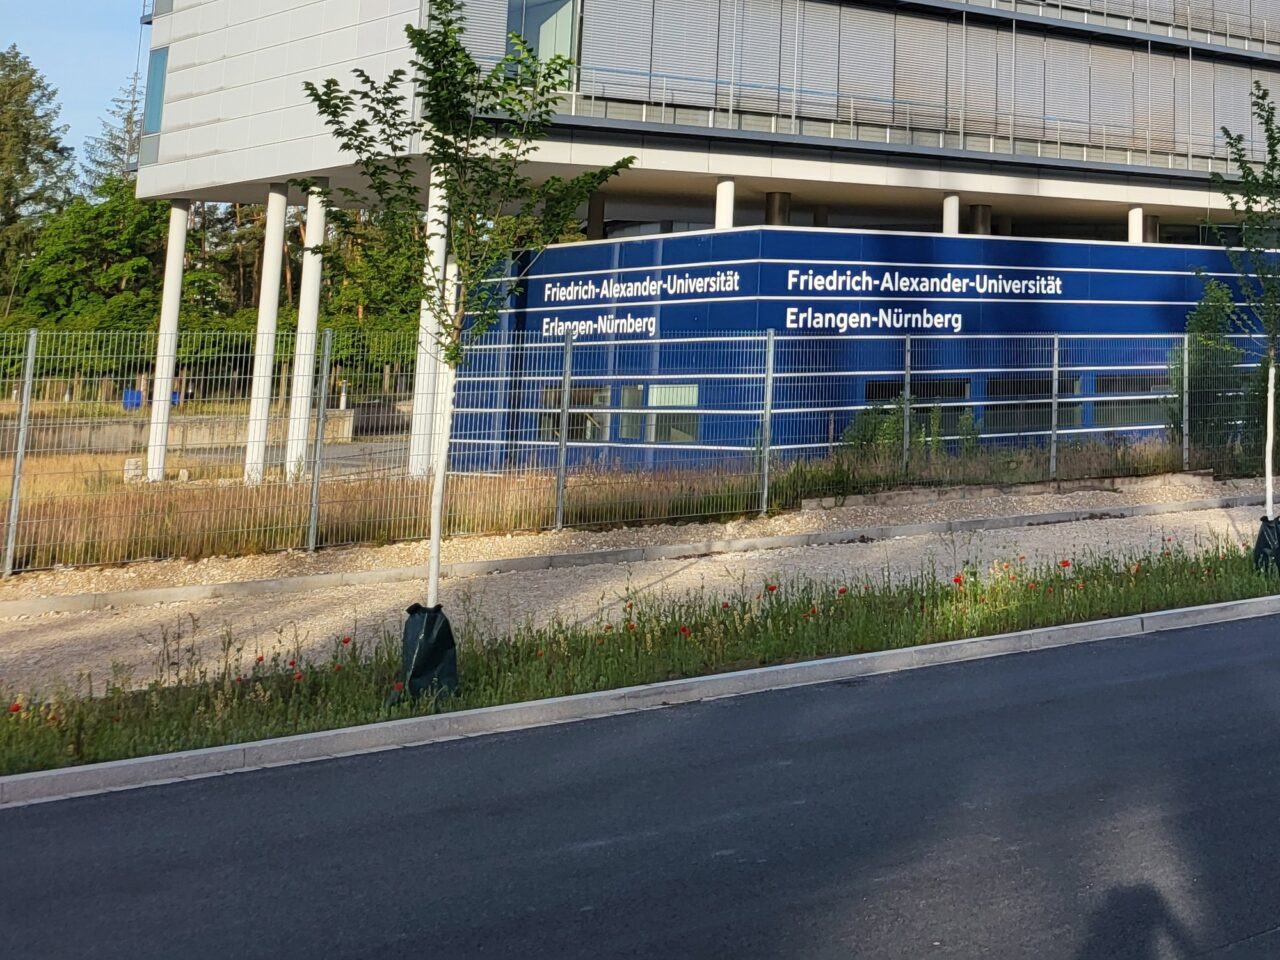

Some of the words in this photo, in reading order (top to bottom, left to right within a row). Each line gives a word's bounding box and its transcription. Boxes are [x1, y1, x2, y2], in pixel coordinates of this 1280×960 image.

[544, 270, 740, 302] Friedrich-Alexander-Universität
[787, 269, 1062, 295] Friedrich-Alexander-Universität
[542, 313, 657, 339] Erlangen-Nürnberg
[785, 307, 962, 333] Erlangen-Nürnberg
